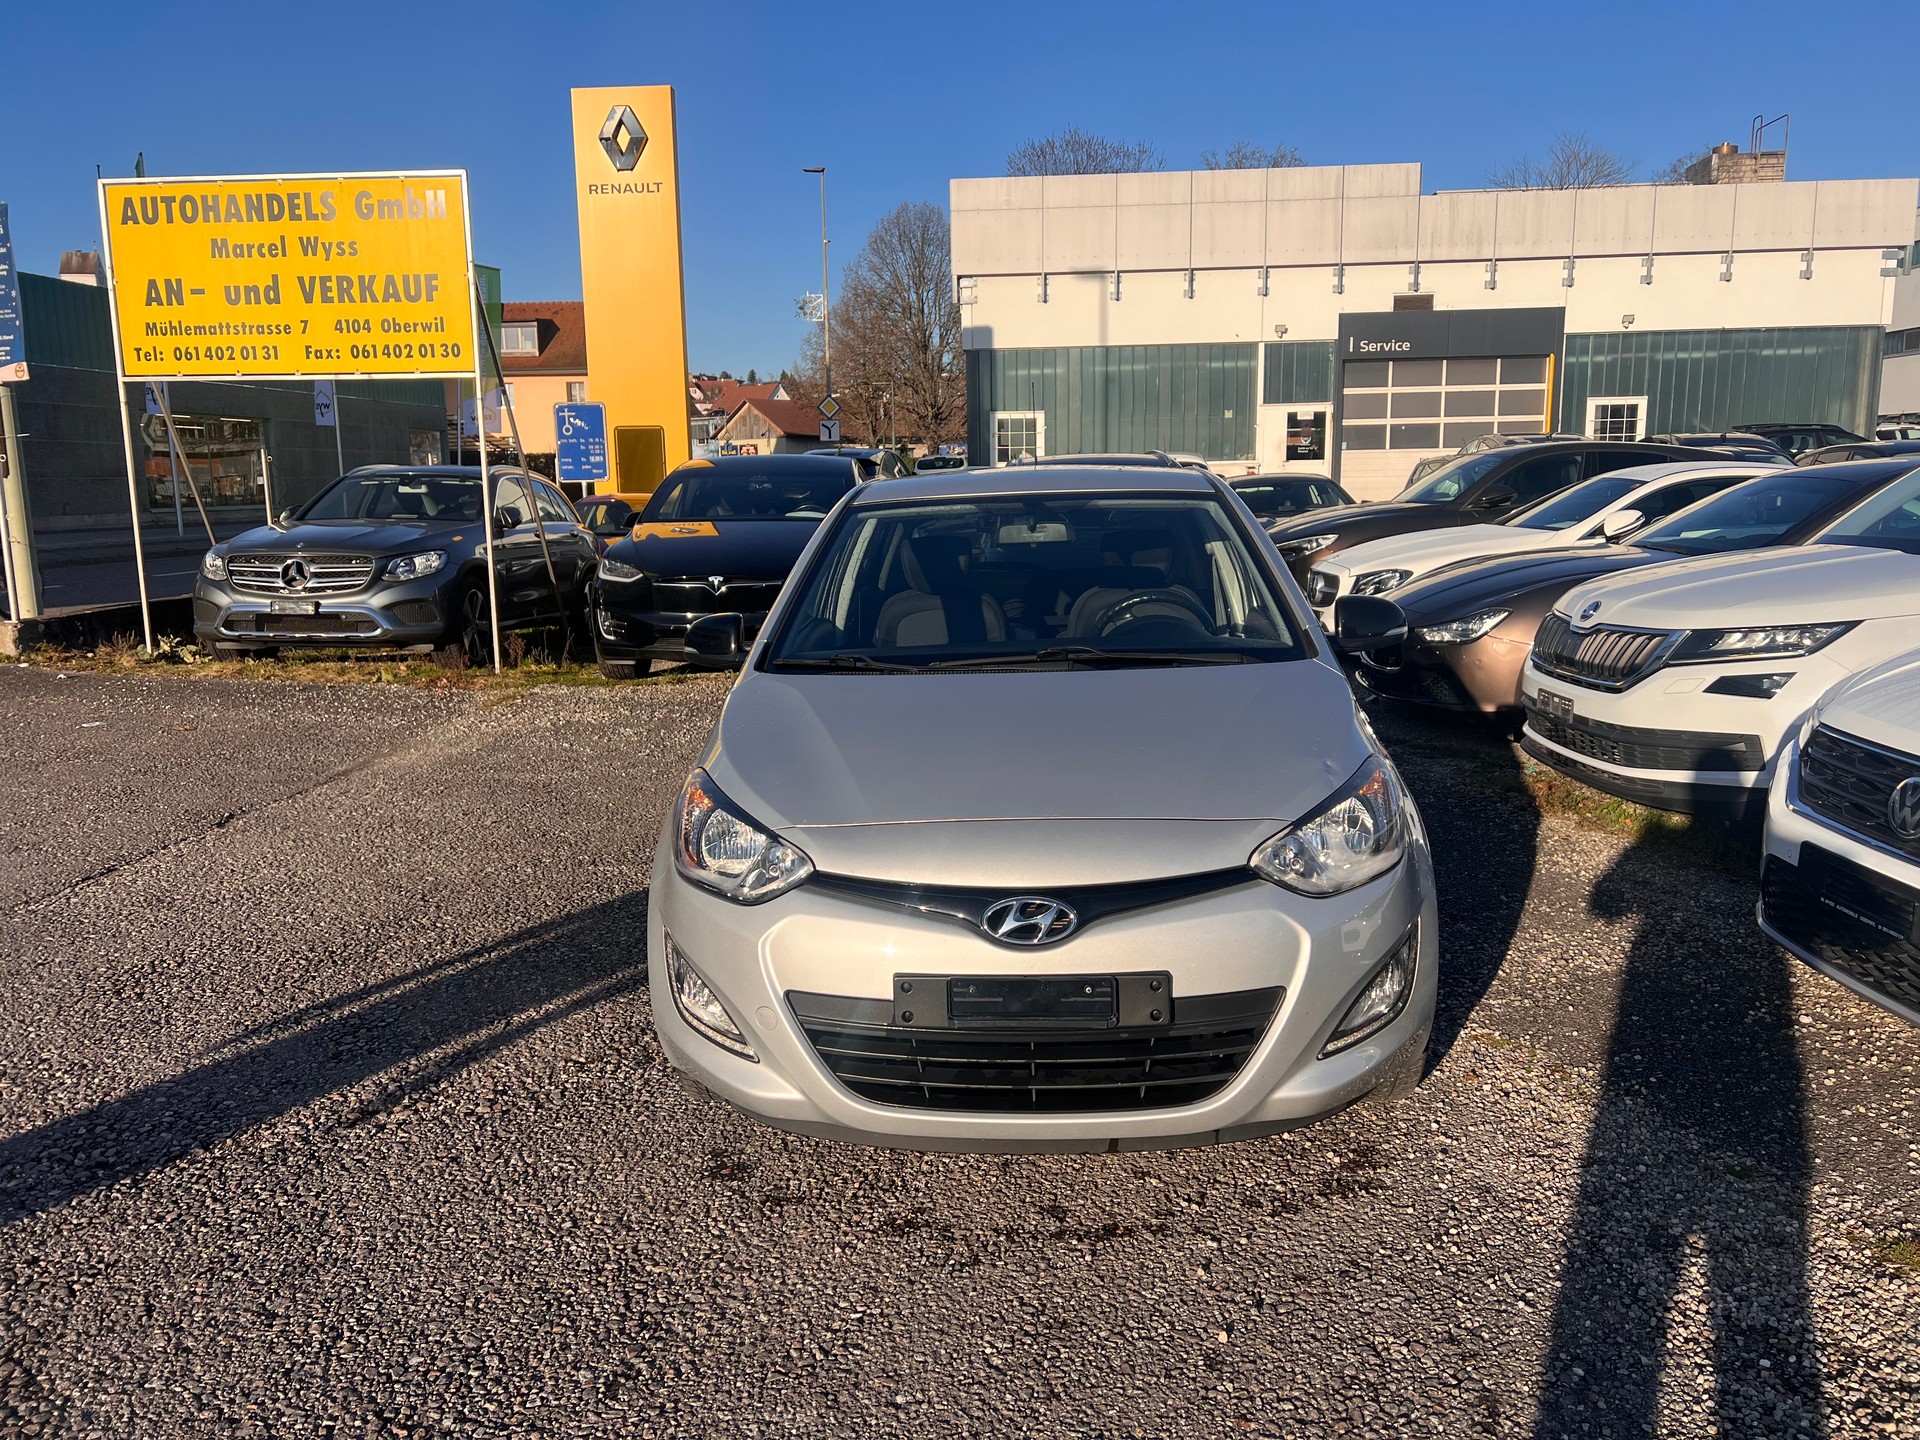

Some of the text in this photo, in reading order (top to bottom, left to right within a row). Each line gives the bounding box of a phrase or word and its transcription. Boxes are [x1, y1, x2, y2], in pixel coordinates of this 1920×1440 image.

[588, 182, 663, 195] RENAULT
[120, 187, 447, 226] AUTOHANDELS GmbH
[210, 235, 359, 262] Marcel Wyss
[223, 274, 281, 306] und
[297, 273, 439, 304] VERKAUF
[145, 316, 445, 337] Mühlemattstrasse 7 4104 Oberwil
[134, 346, 165, 362] Tel:
[304, 345, 341, 360] Fax:
[1359, 339, 1411, 352] Service
